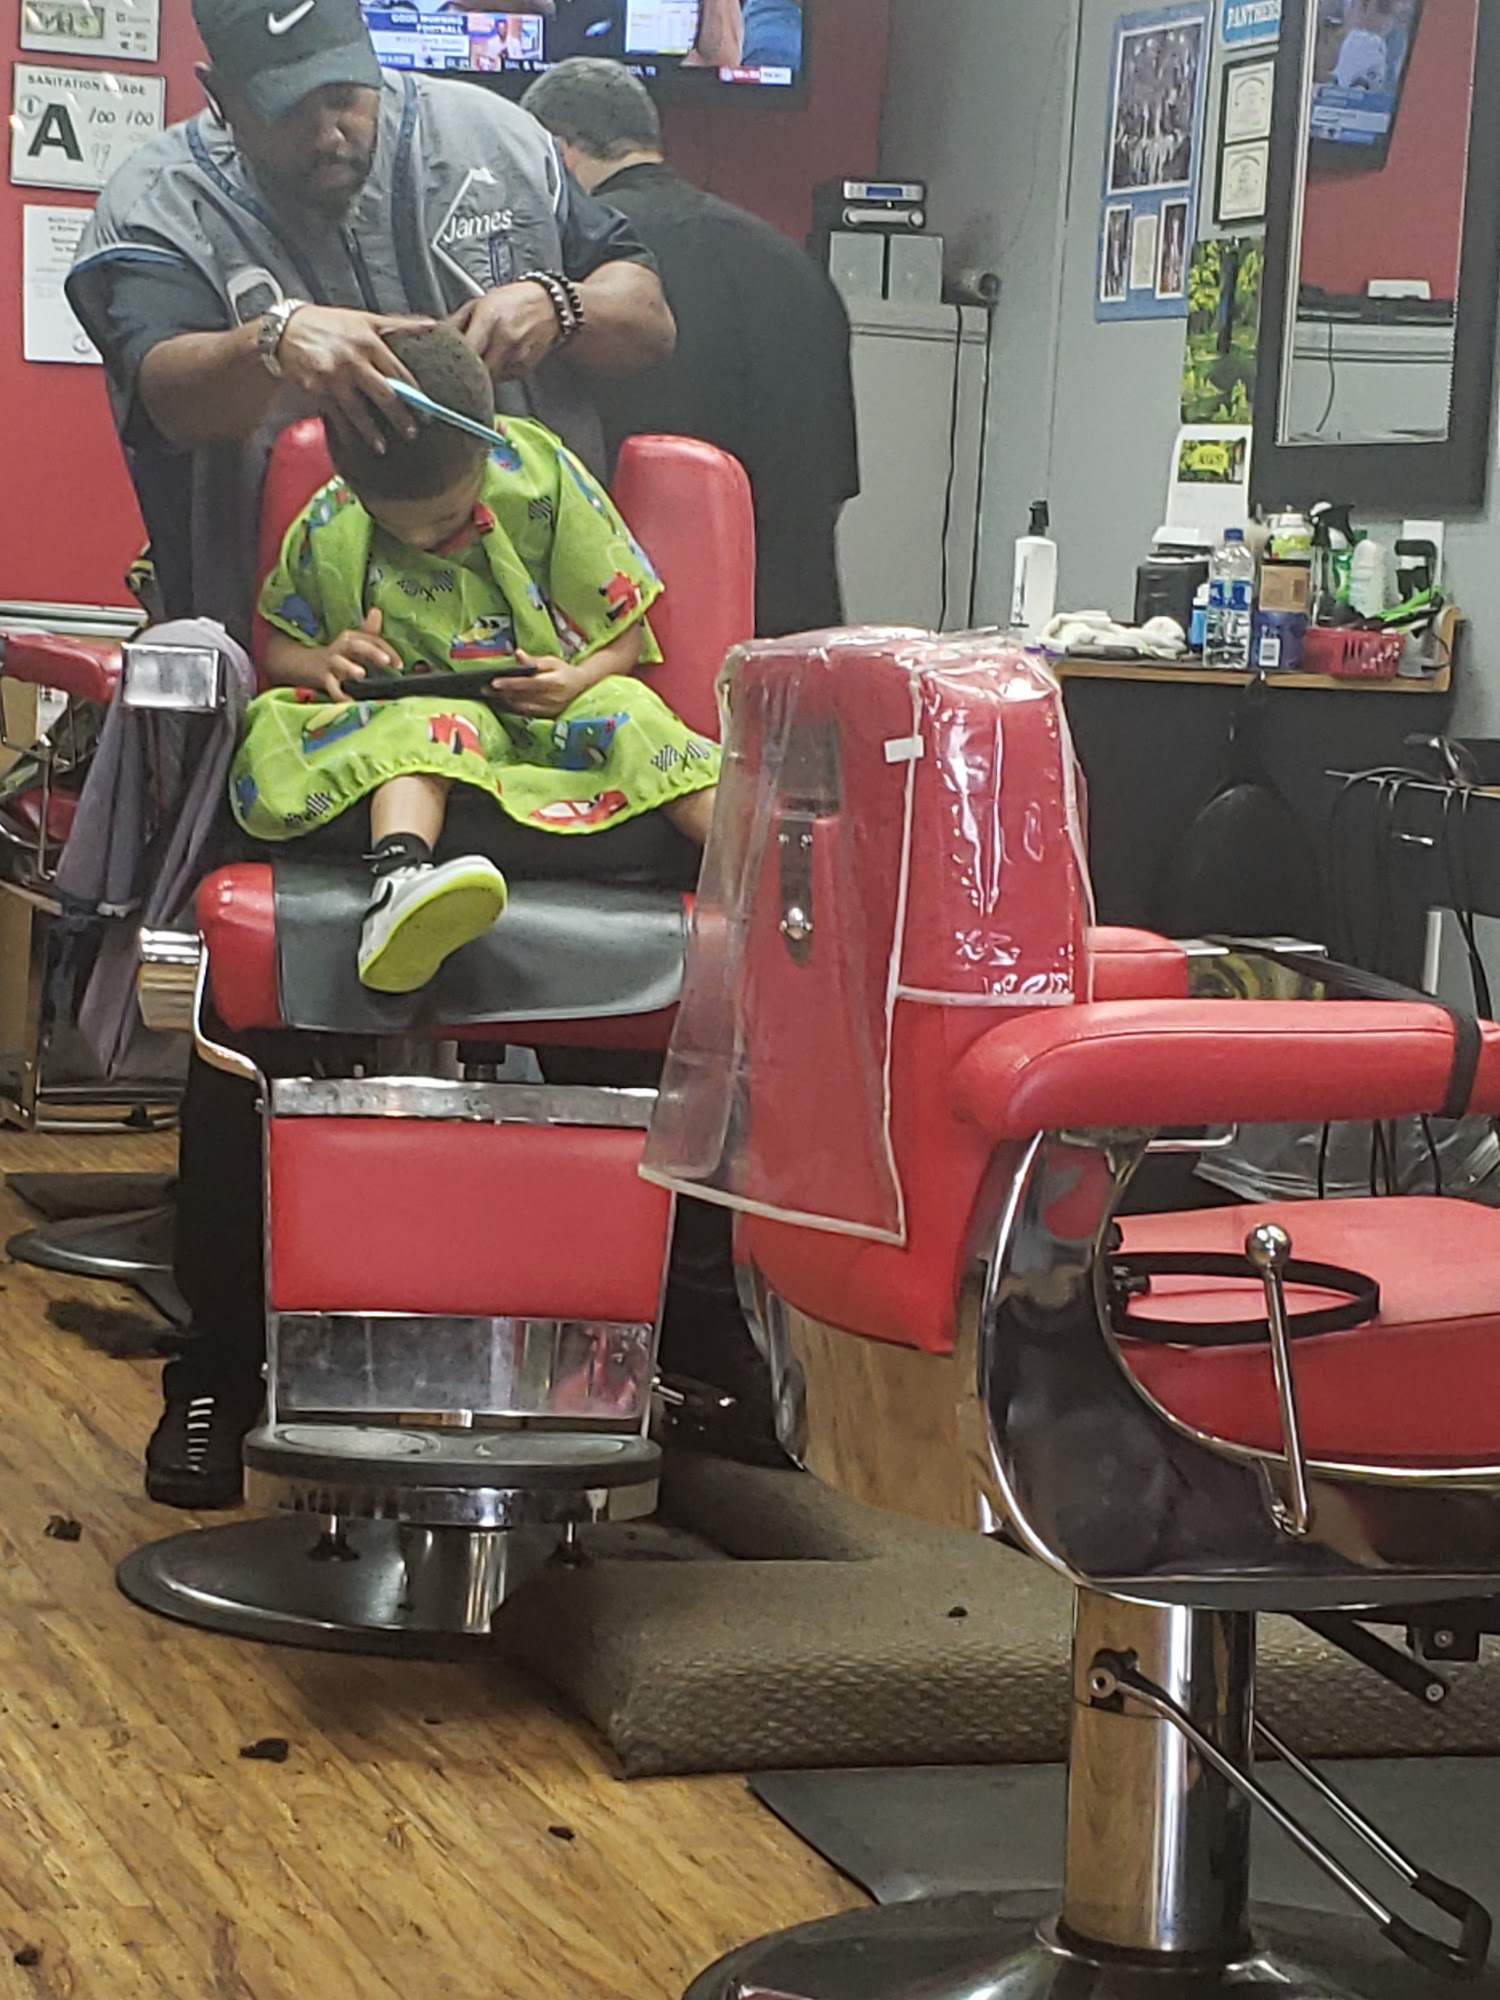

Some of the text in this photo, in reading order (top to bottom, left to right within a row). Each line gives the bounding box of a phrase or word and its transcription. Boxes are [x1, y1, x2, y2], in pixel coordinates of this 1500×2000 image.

[420, 15, 464, 27] MORNING
[27, 74, 146, 96] SANITATION GADE
[89, 106, 116, 124] 100
[27, 102, 84, 162] A
[443, 208, 513, 243] James
